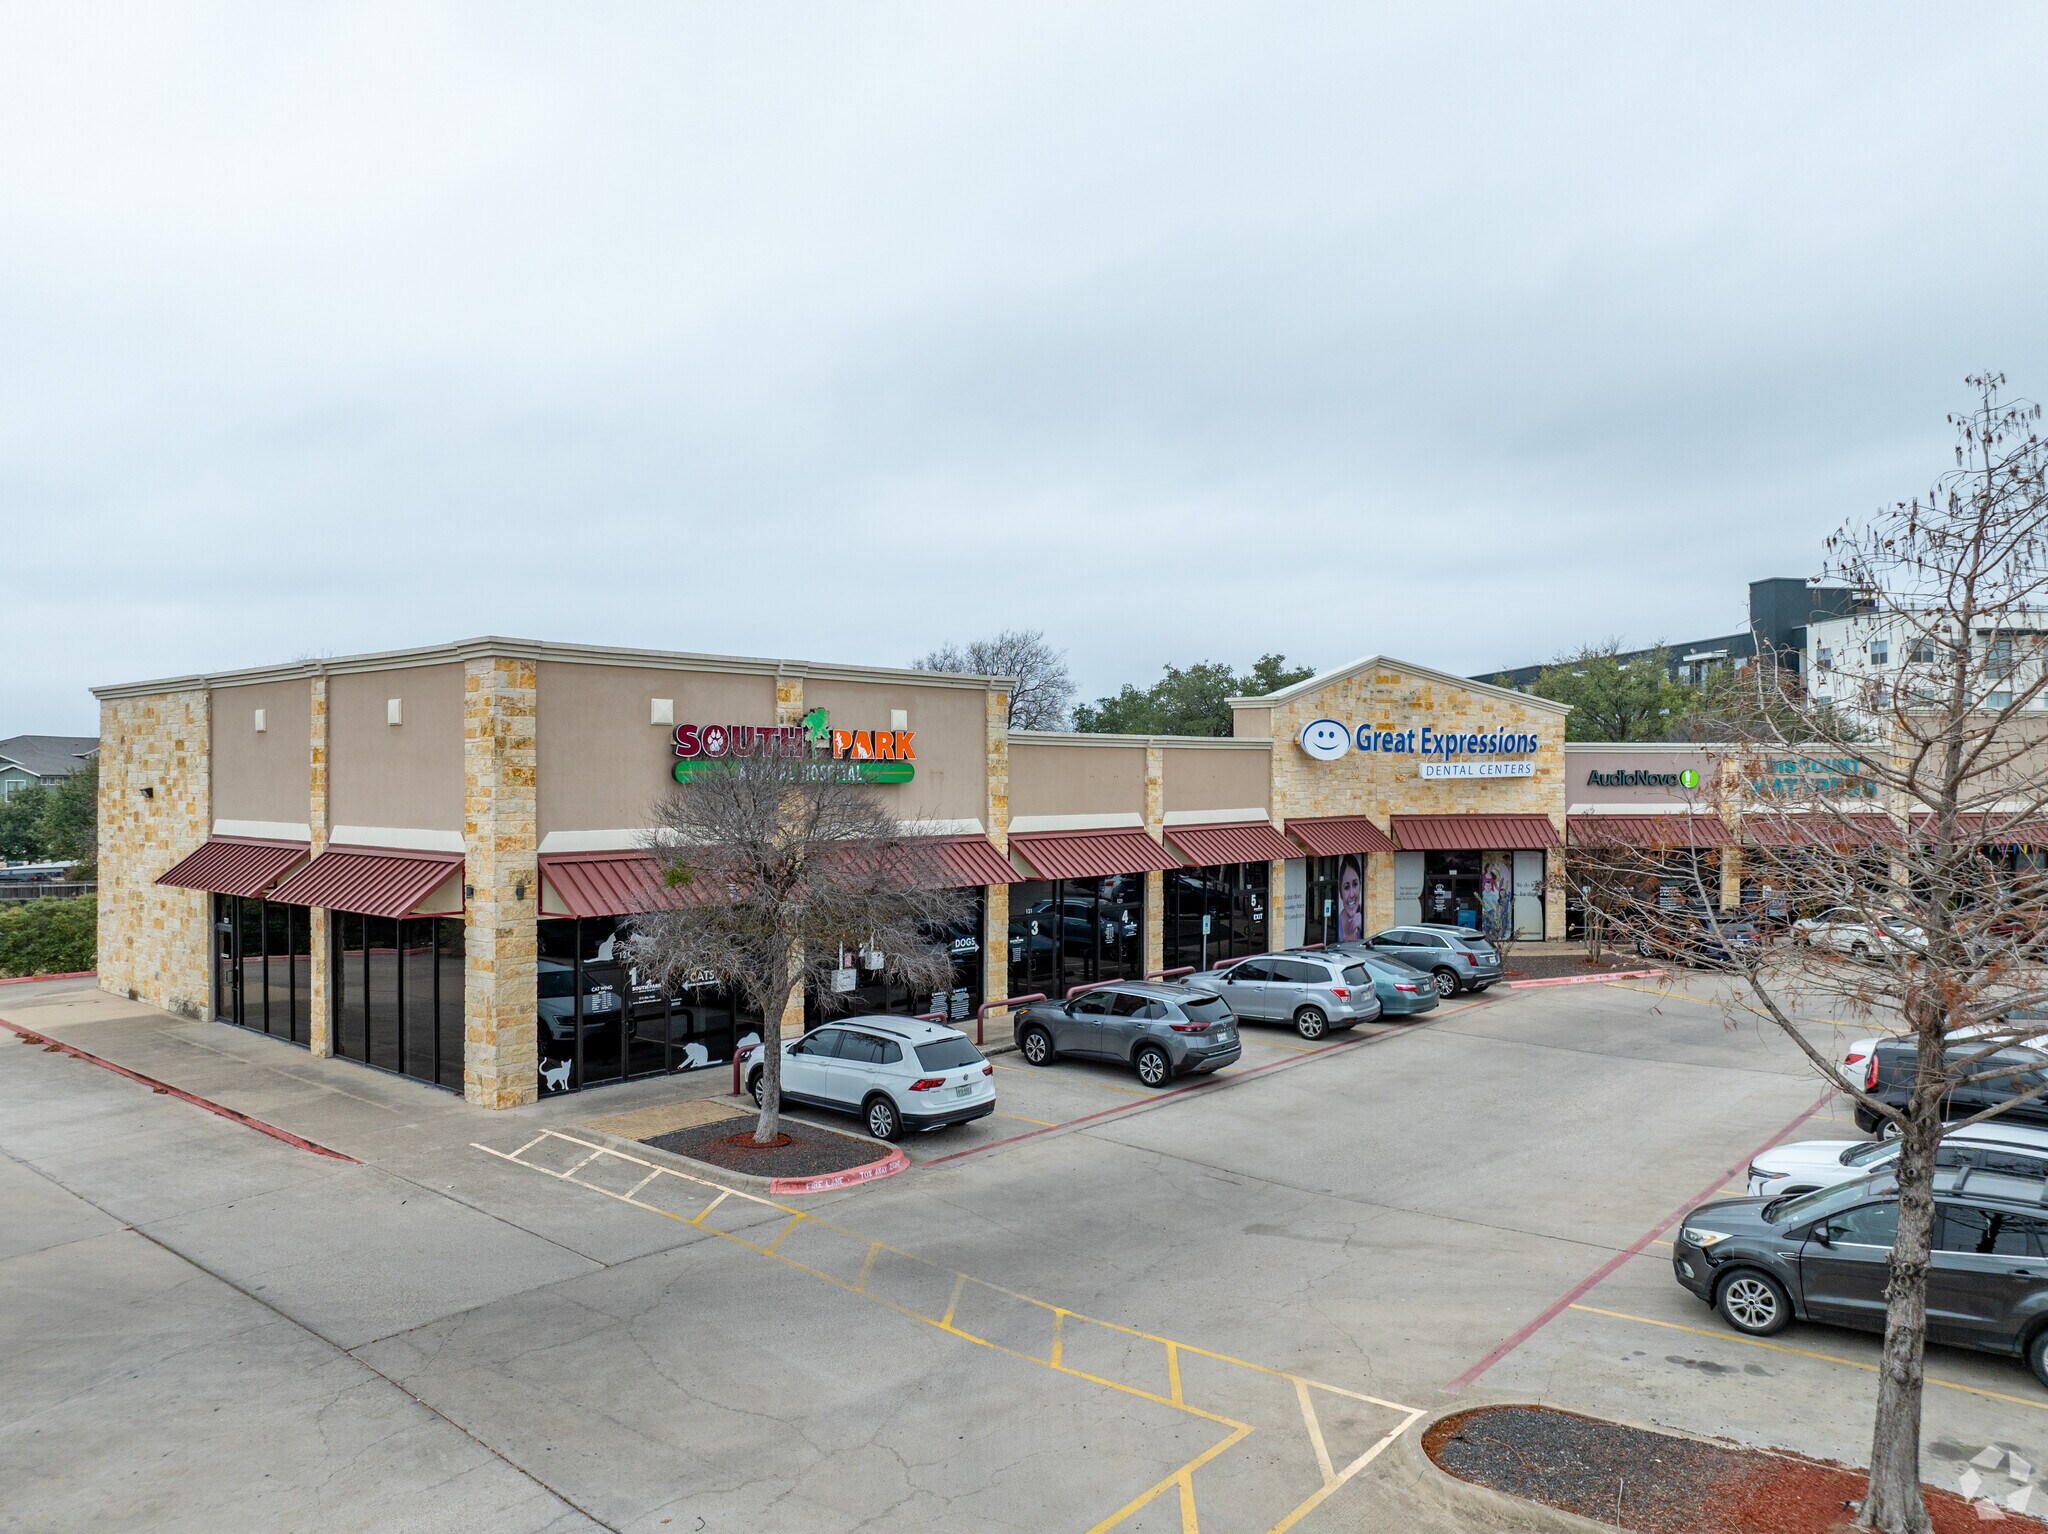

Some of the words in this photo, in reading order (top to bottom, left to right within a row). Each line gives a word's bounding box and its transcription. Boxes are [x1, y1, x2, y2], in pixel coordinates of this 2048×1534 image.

[674, 724, 803, 758] SOUTH
[832, 729, 917, 760] PARK
[1355, 723, 1415, 753] Great
[1420, 726, 1537, 761] Expressions
[738, 764, 795, 781] AAL
[1426, 765, 1473, 776] DENTAL
[1479, 764, 1531, 775] CENTERS
[1587, 769, 1679, 786] AudioNova
[1251, 894, 1257, 907] 5
[1121, 910, 1129, 923] 4
[1031, 920, 1039, 936] 3
[955, 937, 976, 948] DOGS
[629, 967, 638, 986] 1
[690, 970, 715, 982] CATS
[806, 1180, 823, 1190] FIRE
[825, 1176, 844, 1188] LANE
